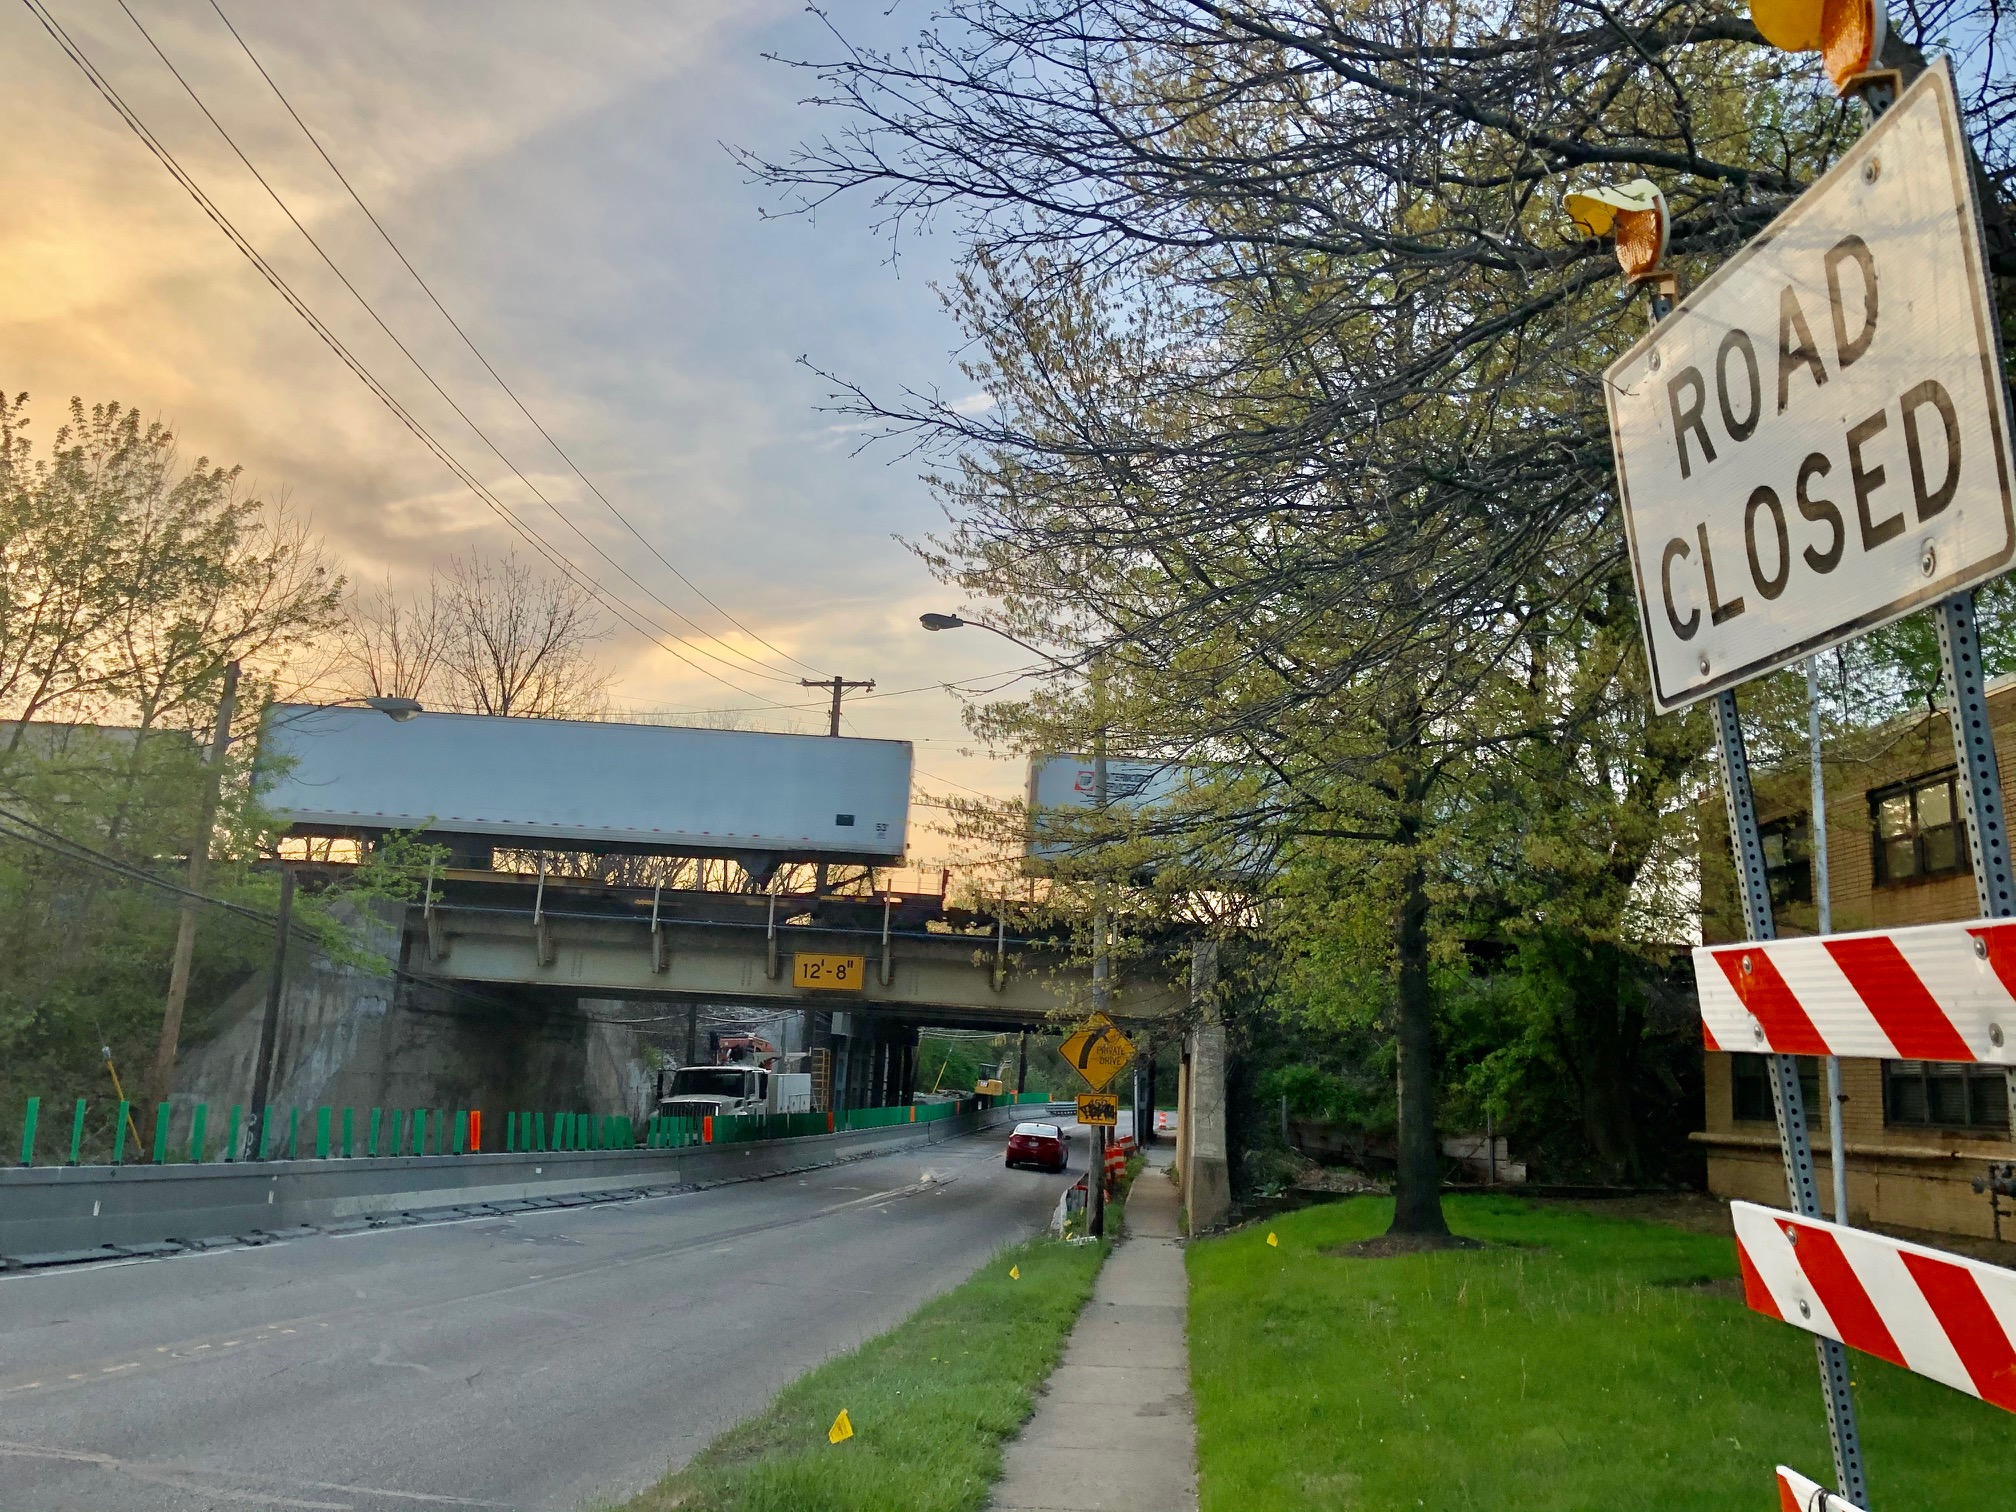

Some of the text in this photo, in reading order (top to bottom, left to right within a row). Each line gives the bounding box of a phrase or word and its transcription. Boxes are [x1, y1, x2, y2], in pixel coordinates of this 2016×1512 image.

[1667, 234, 1879, 480] ROAD
[1661, 379, 1962, 641] CLOSED
[803, 958, 854, 980] 12'-8"
[1096, 1045, 1125, 1055] PRIVATE
[1099, 1056, 1122, 1066] DRIVE
